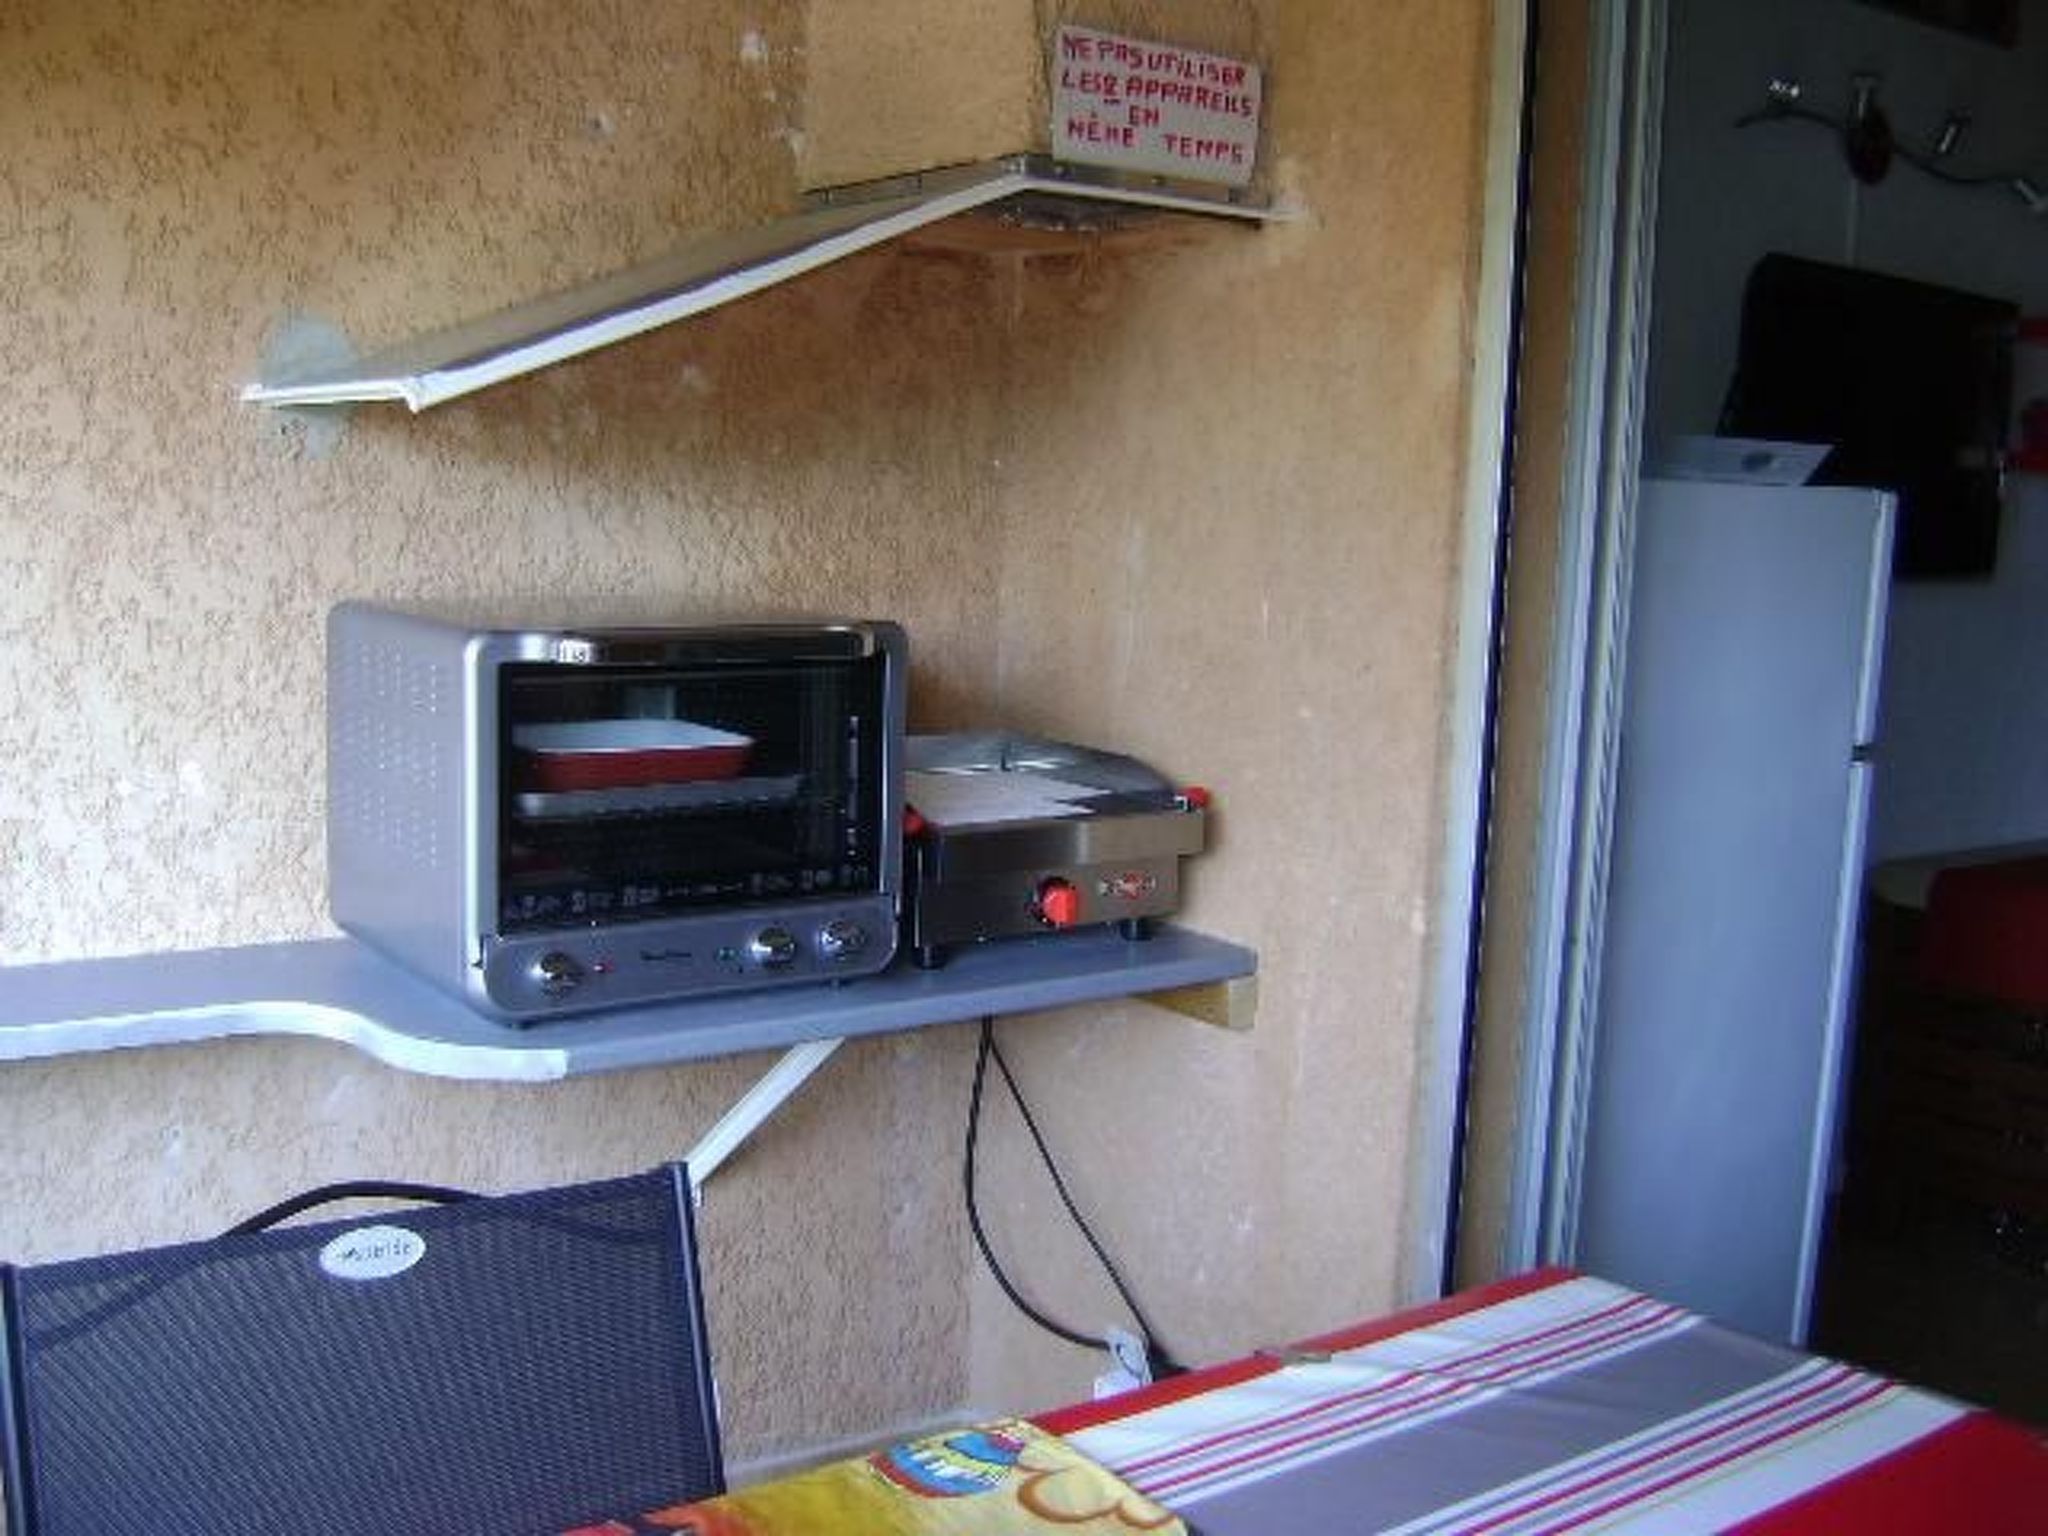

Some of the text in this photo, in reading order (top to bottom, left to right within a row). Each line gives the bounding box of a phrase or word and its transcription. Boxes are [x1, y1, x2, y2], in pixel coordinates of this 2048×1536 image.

[1062, 33, 1092, 61] NE
[1097, 40, 1143, 69] PAS
[1129, 104, 1159, 126] EN
[1163, 132, 1243, 164] TEMPS
